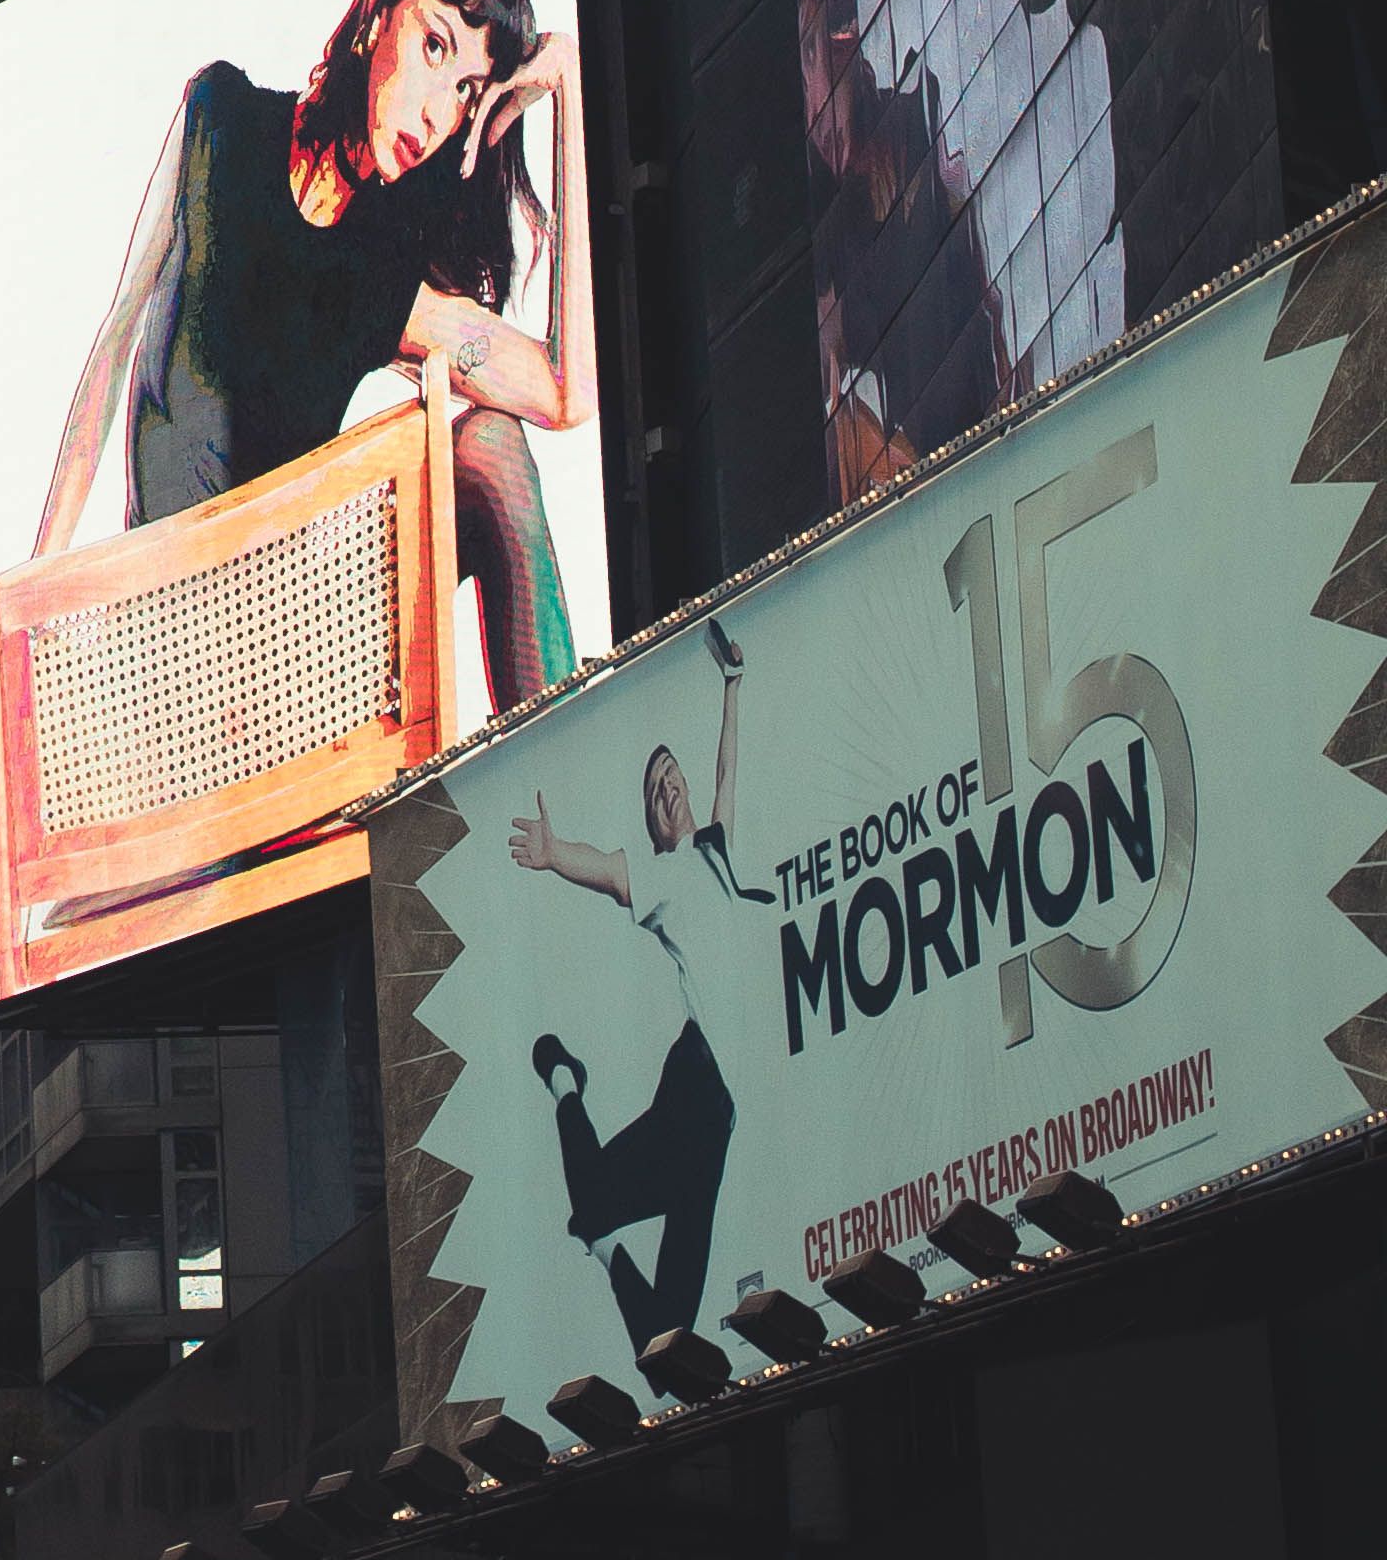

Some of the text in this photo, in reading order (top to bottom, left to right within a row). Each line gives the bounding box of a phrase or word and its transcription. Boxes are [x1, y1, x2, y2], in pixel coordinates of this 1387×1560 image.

[775, 758, 979, 913] THE BOOK OF
[779, 736, 1157, 1057] MORMON
[967, 1126, 1043, 1207] YEARS
[1044, 1109, 1079, 1176] ON
[1079, 1047, 1216, 1164] BROADWAY!
